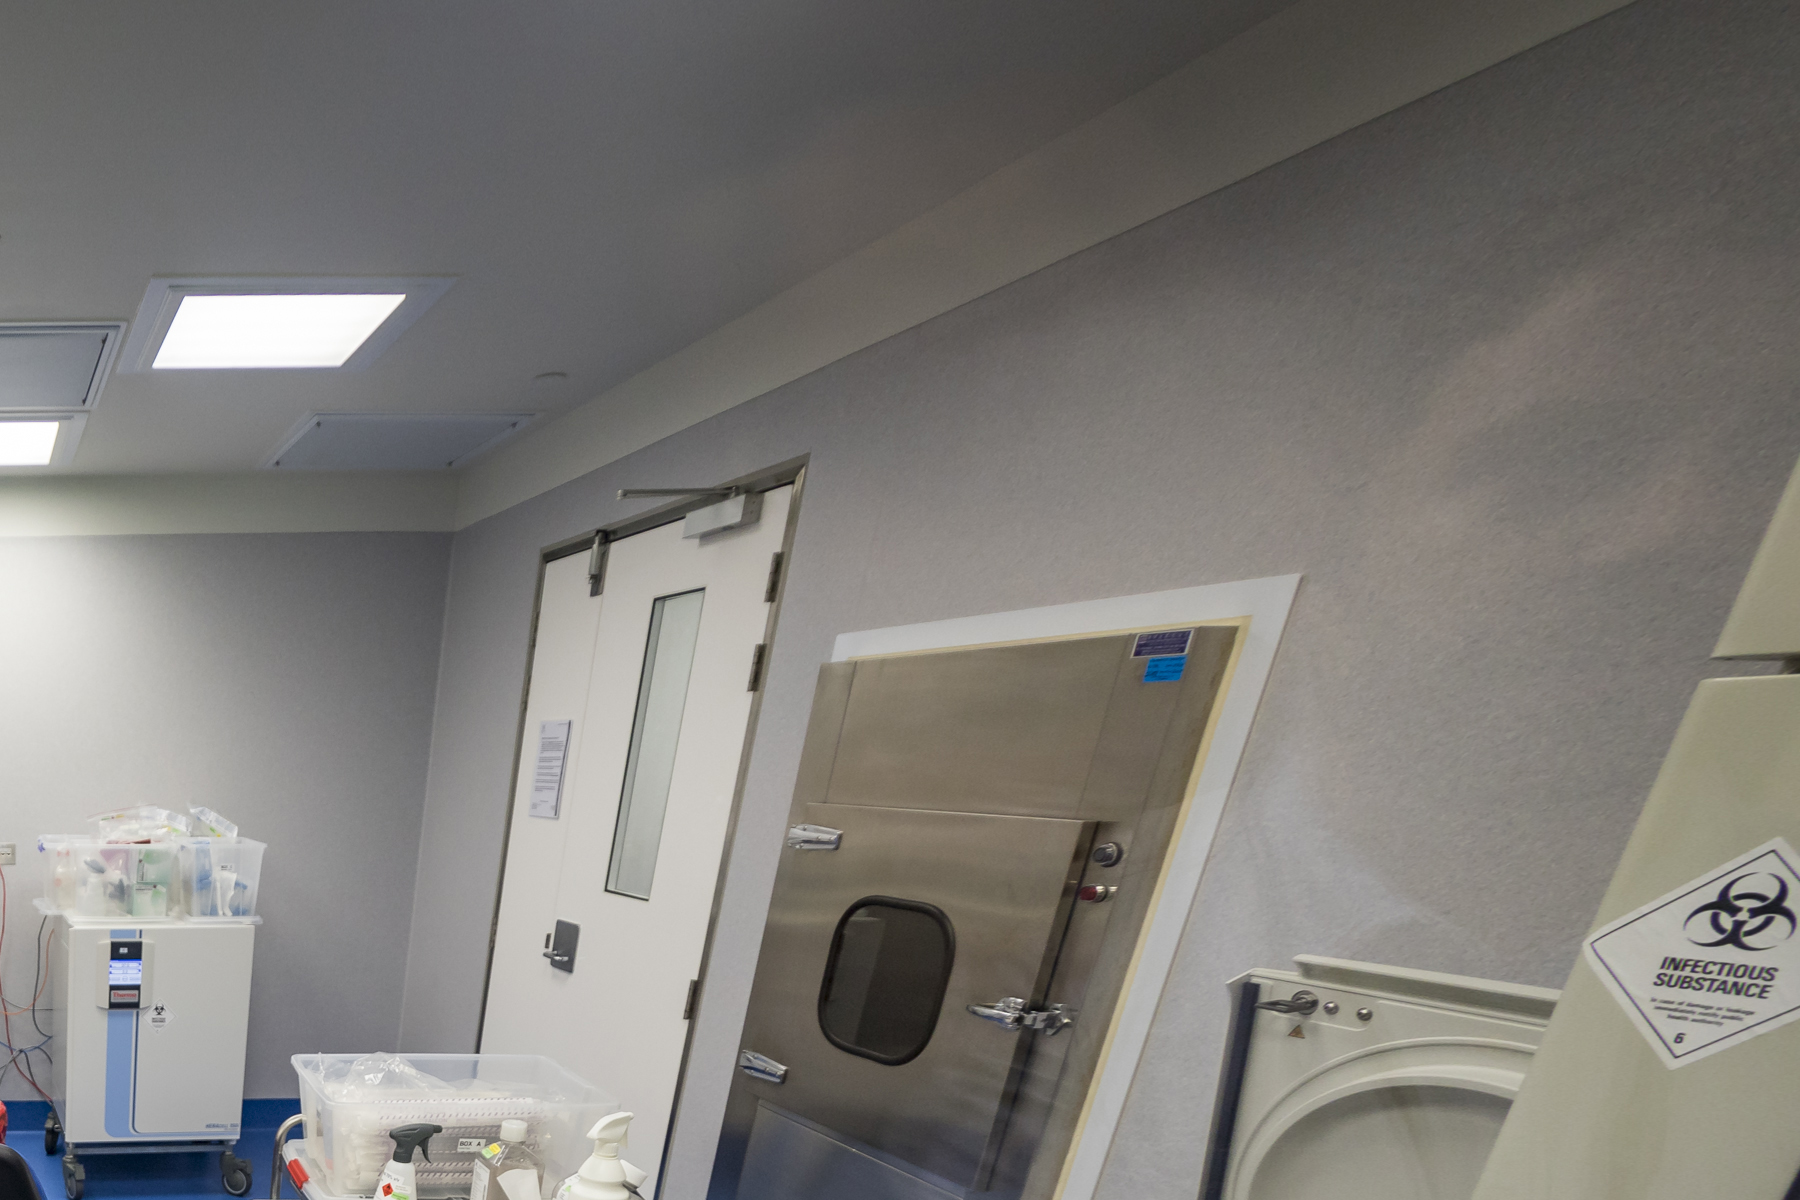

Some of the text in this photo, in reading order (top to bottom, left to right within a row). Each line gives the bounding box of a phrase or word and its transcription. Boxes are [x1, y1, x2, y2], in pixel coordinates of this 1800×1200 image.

[1660, 956, 1779, 982] INFECTIOUS
[1653, 972, 1774, 1000] SUBSTANCE
[1673, 1032, 1686, 1044] 6
